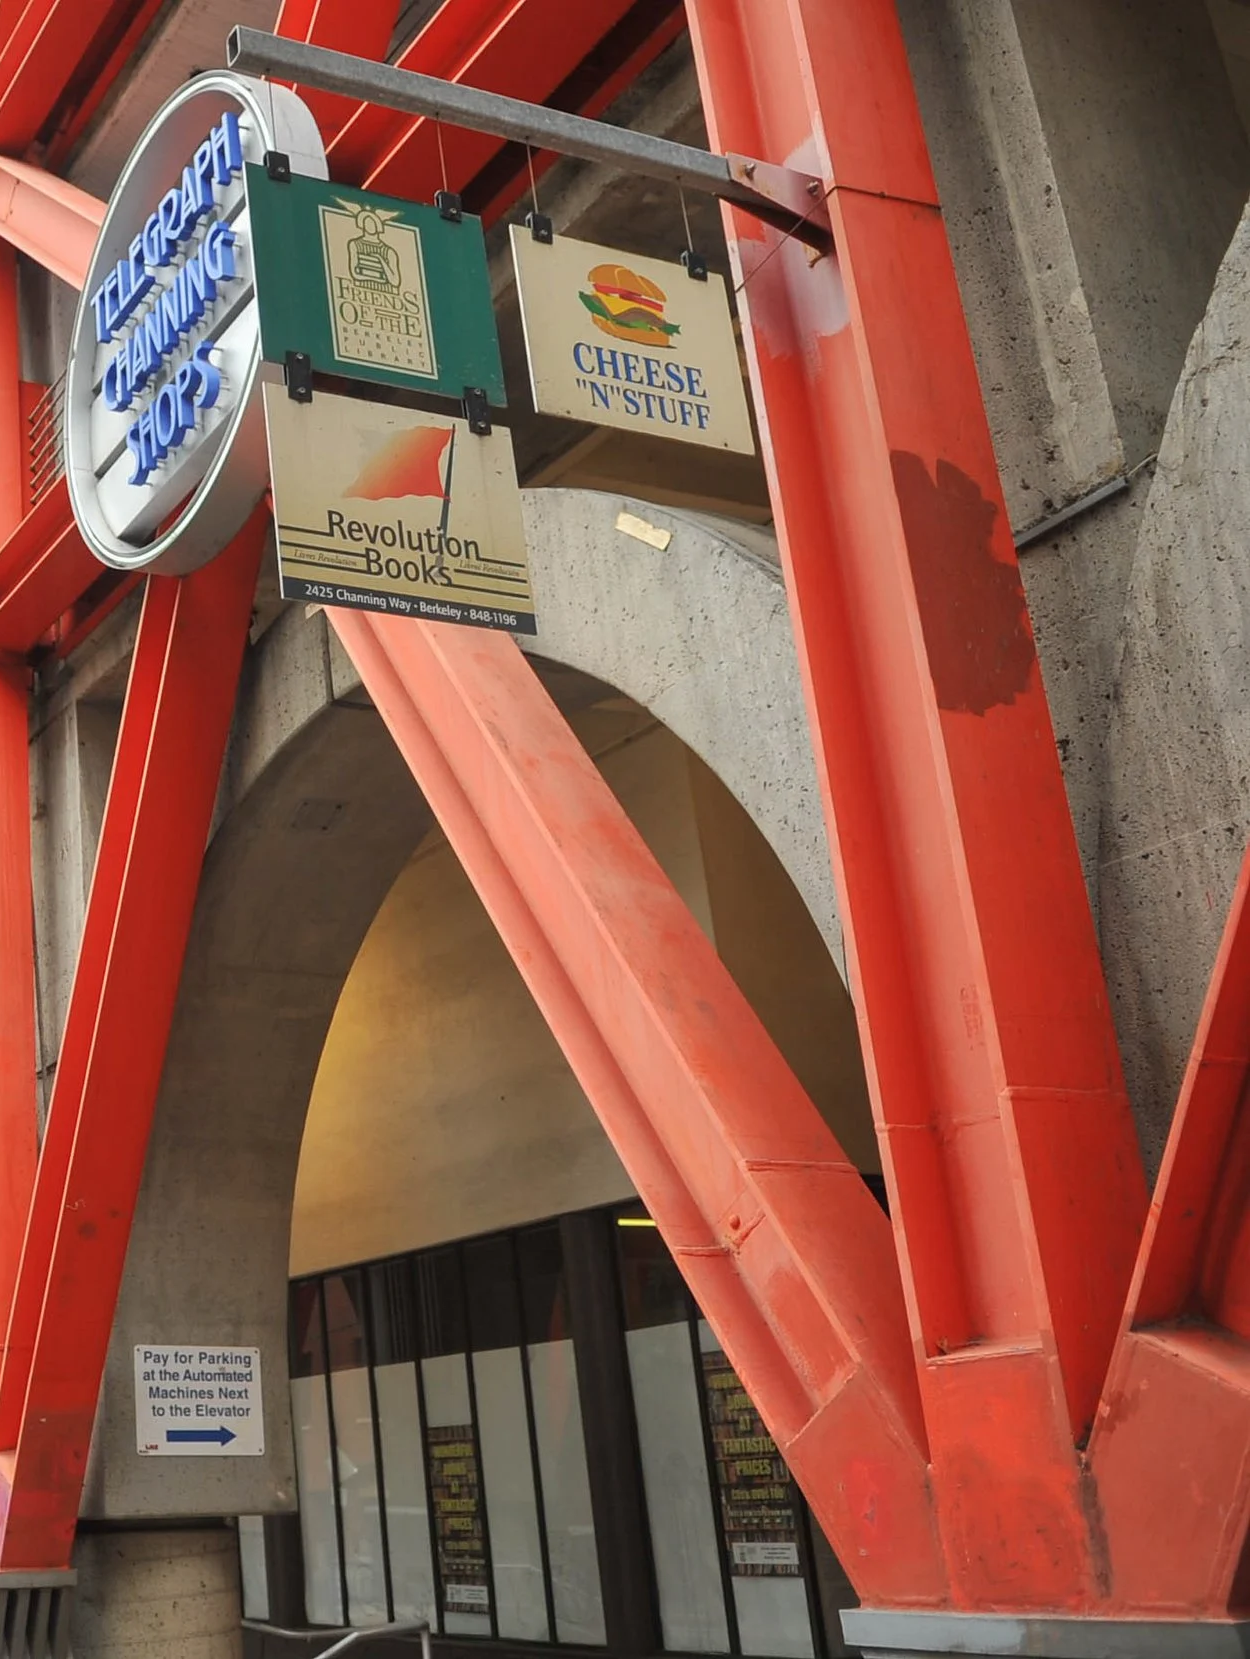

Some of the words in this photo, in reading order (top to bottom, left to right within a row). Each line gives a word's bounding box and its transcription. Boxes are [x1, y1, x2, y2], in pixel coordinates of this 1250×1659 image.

[90, 111, 243, 344] TELEGRAPH
[334, 276, 420, 315] FRIENDS
[102, 220, 236, 412] CHANNING
[339, 301, 371, 325] OF
[375, 314, 422, 338] THE
[343, 327, 423, 348] BERKELEY
[573, 342, 707, 398] CHEESE
[126, 340, 220, 486] SHOPS
[327, 510, 480, 561] Revolution
[365, 547, 452, 587] Books
[305, 583, 333, 598] 2425
[336, 589, 386, 609] Channing
[389, 597, 411, 612] Way
[419, 601, 461, 620] Berkeley
[470, 609, 517, 626] 848-1196
[143, 1351, 169, 1367] Pay
[174, 1351, 194, 1364] for
[199, 1352, 252, 1368] Parking
[143, 1370, 155, 1381] at
[159, 1369, 179, 1381] the
[183, 1369, 252, 1382] Automated
[149, 1386, 214, 1399] Machines
[218, 1387, 249, 1399] Next
[152, 1405, 165, 1417] to
[170, 1405, 191, 1416] the
[195, 1405, 251, 1417] Elevator
